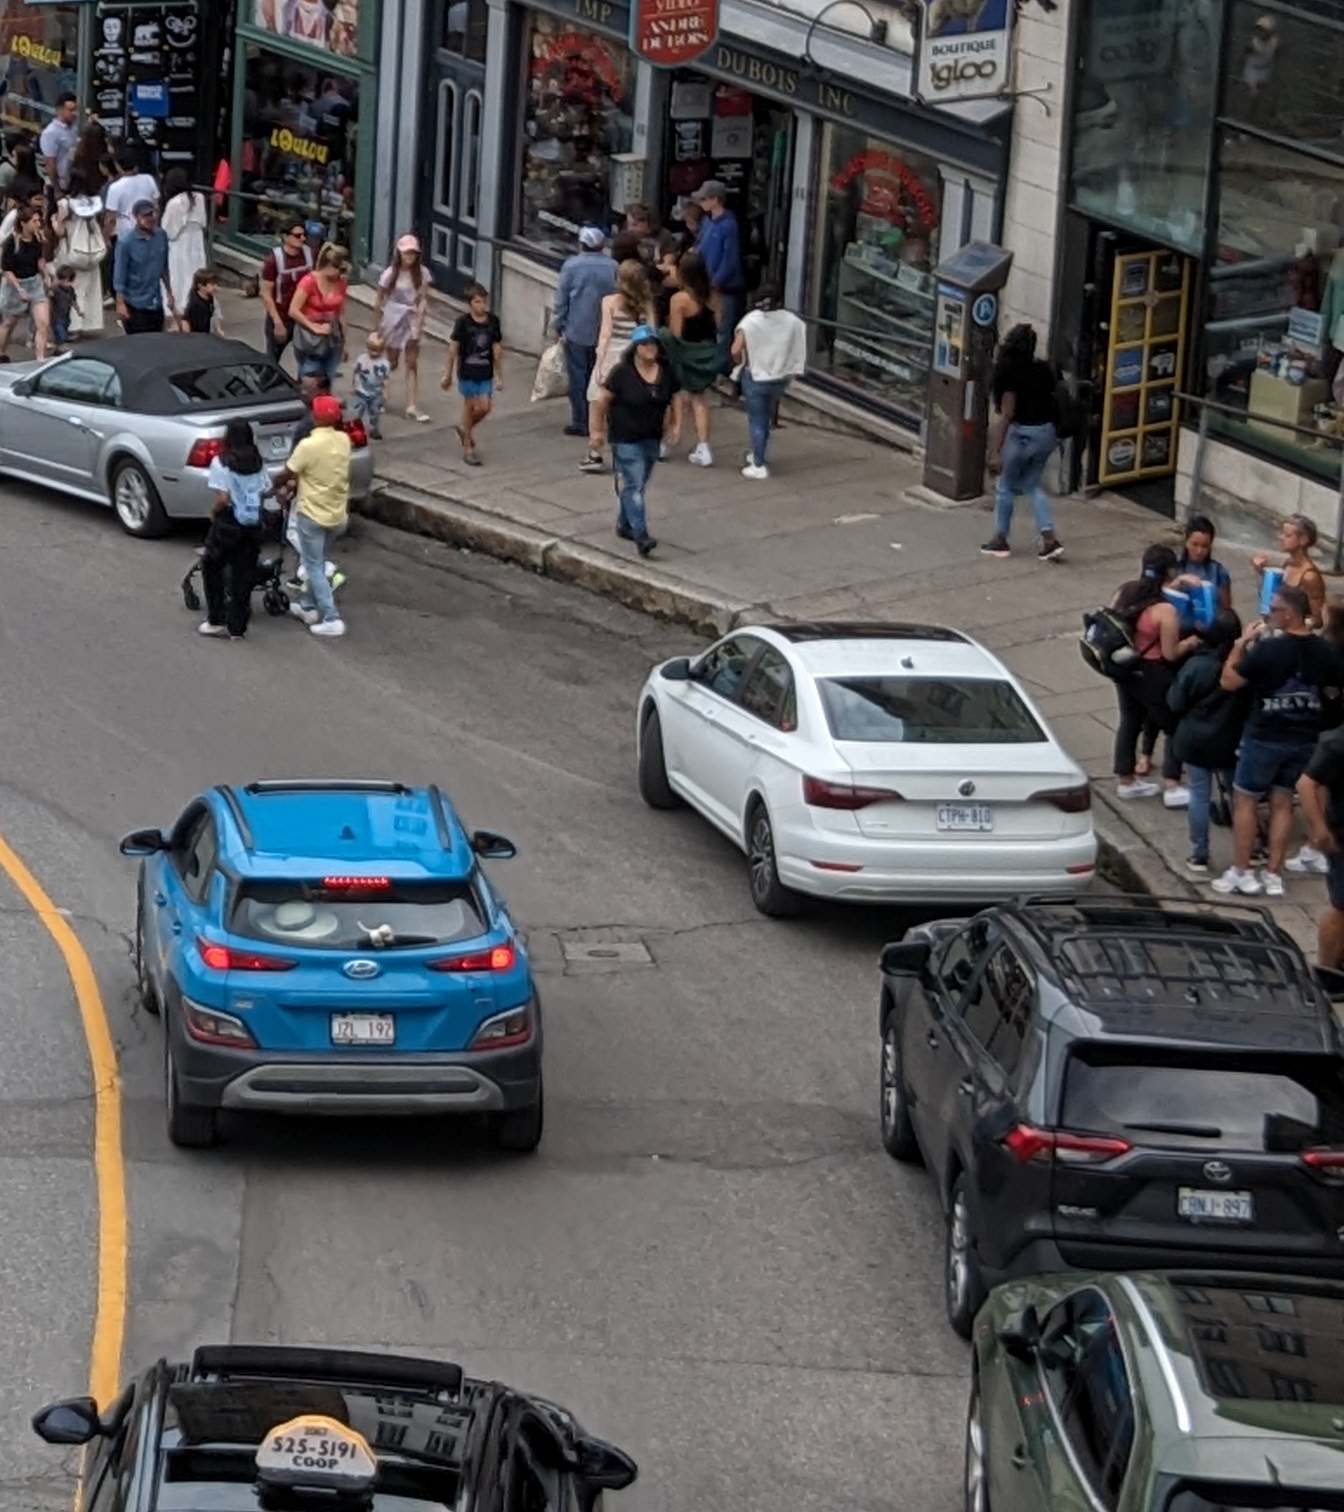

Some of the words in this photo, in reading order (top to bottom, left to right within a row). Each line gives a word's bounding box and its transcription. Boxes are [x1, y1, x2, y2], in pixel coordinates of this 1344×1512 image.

[11, 34, 62, 68] LOULOU
[932, 38, 997, 56] BOUTIQUE
[717, 47, 798, 94] DUBOIS
[818, 83, 857, 116] INC
[270, 128, 329, 165] LOULOU
[272, 1436, 357, 1459] 525-5191
[292, 1455, 340, 1469] COOP
